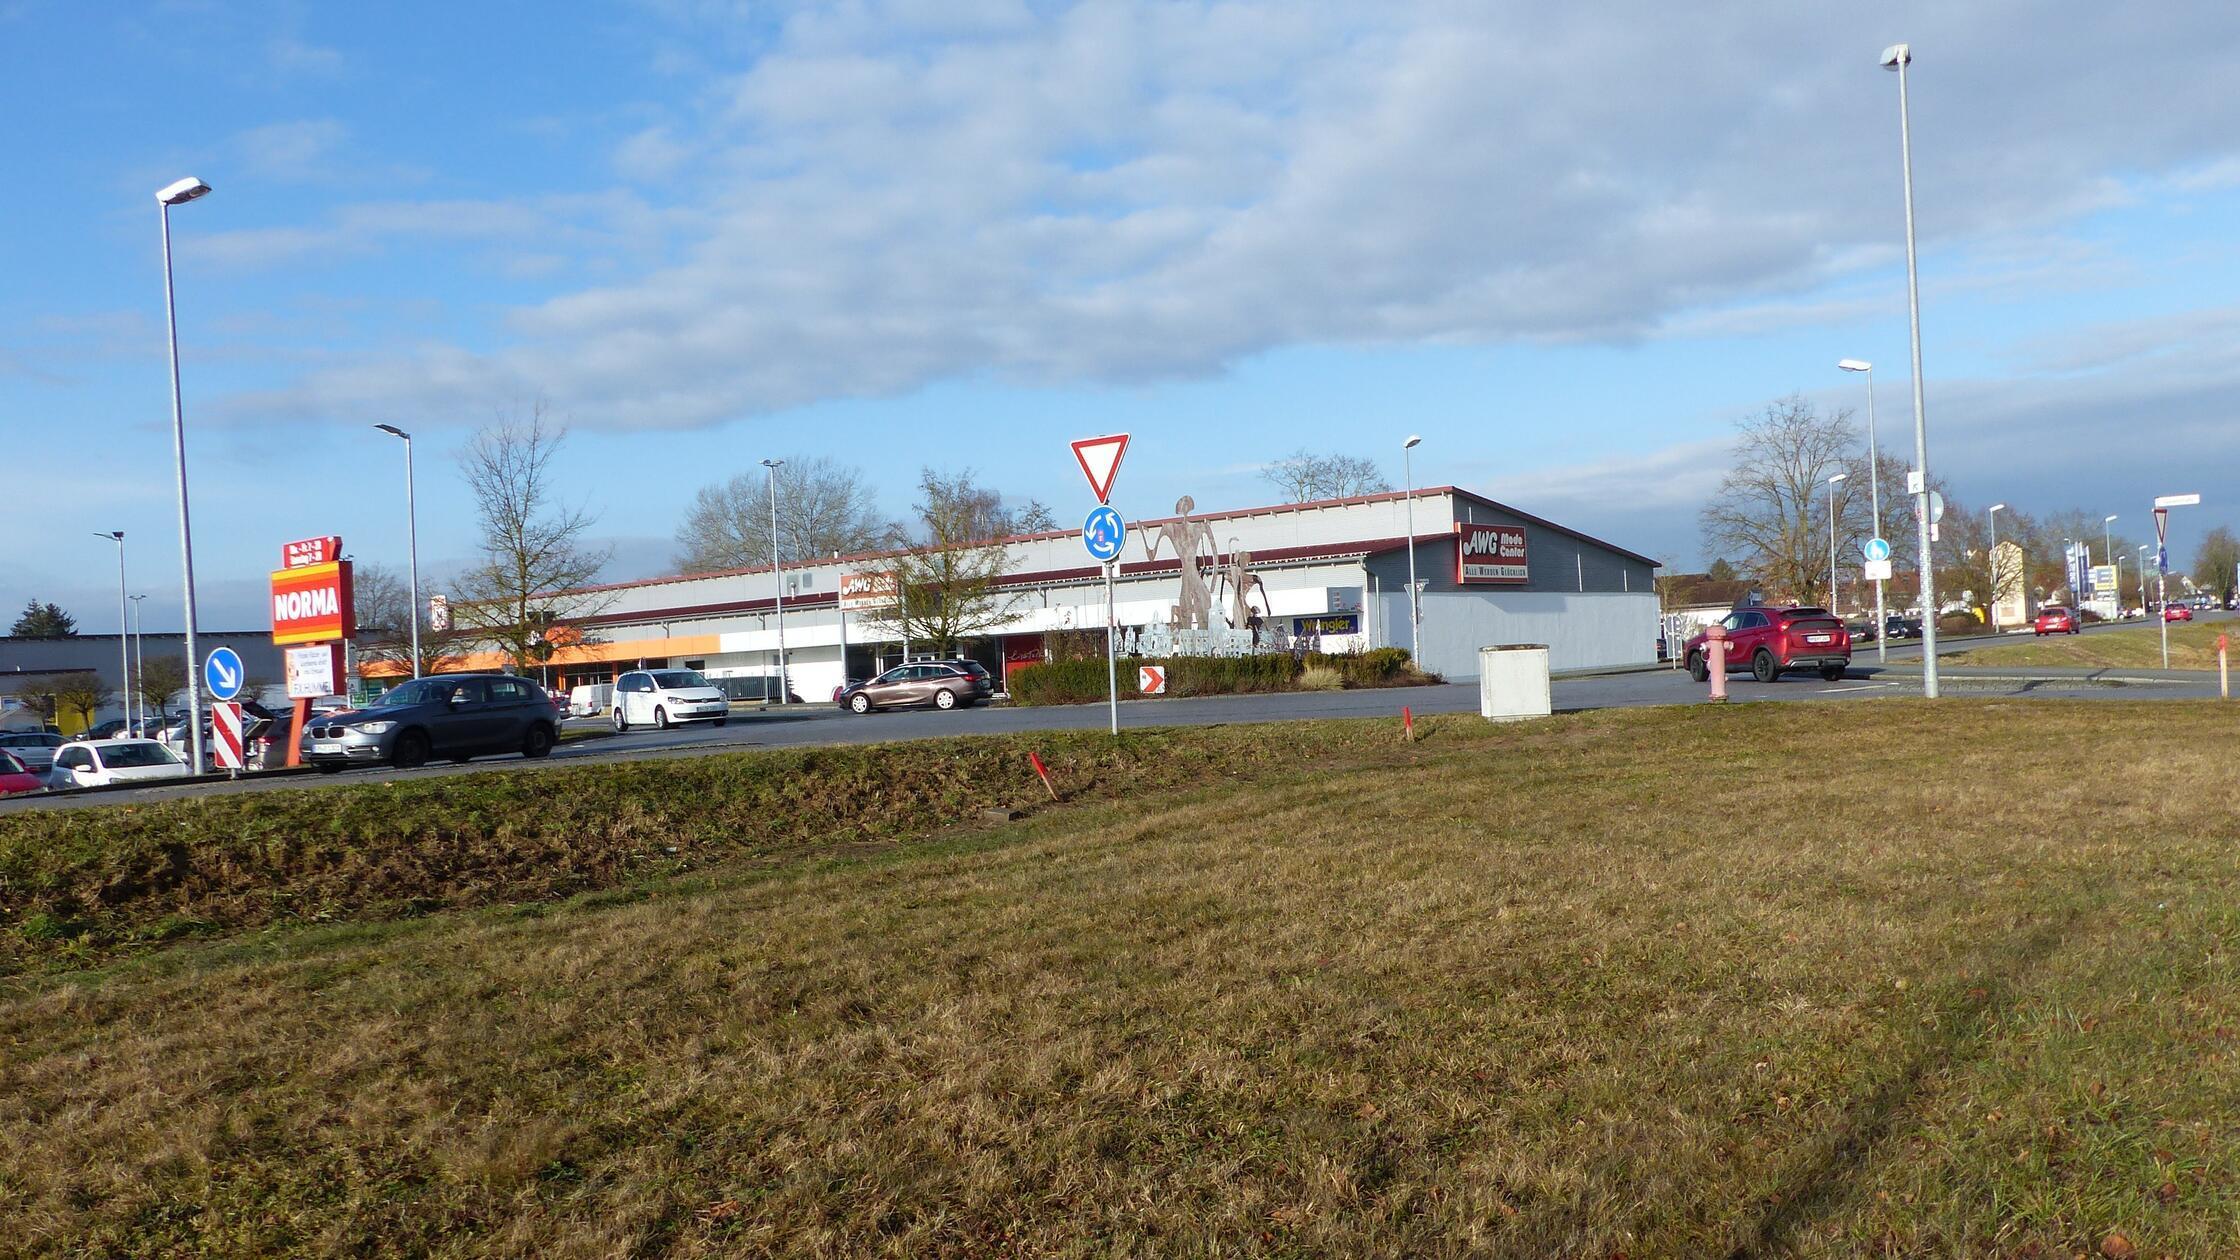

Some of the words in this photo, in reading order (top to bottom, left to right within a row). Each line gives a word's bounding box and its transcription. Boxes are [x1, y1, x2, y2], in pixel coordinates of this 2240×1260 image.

[1463, 531, 1498, 556] AWG
[1500, 533, 1523, 545] Mode
[1500, 545, 1525, 558] Center
[842, 577, 871, 596] AWG
[274, 587, 339, 622] NORMA
[1302, 618, 1350, 633] Wrngler
